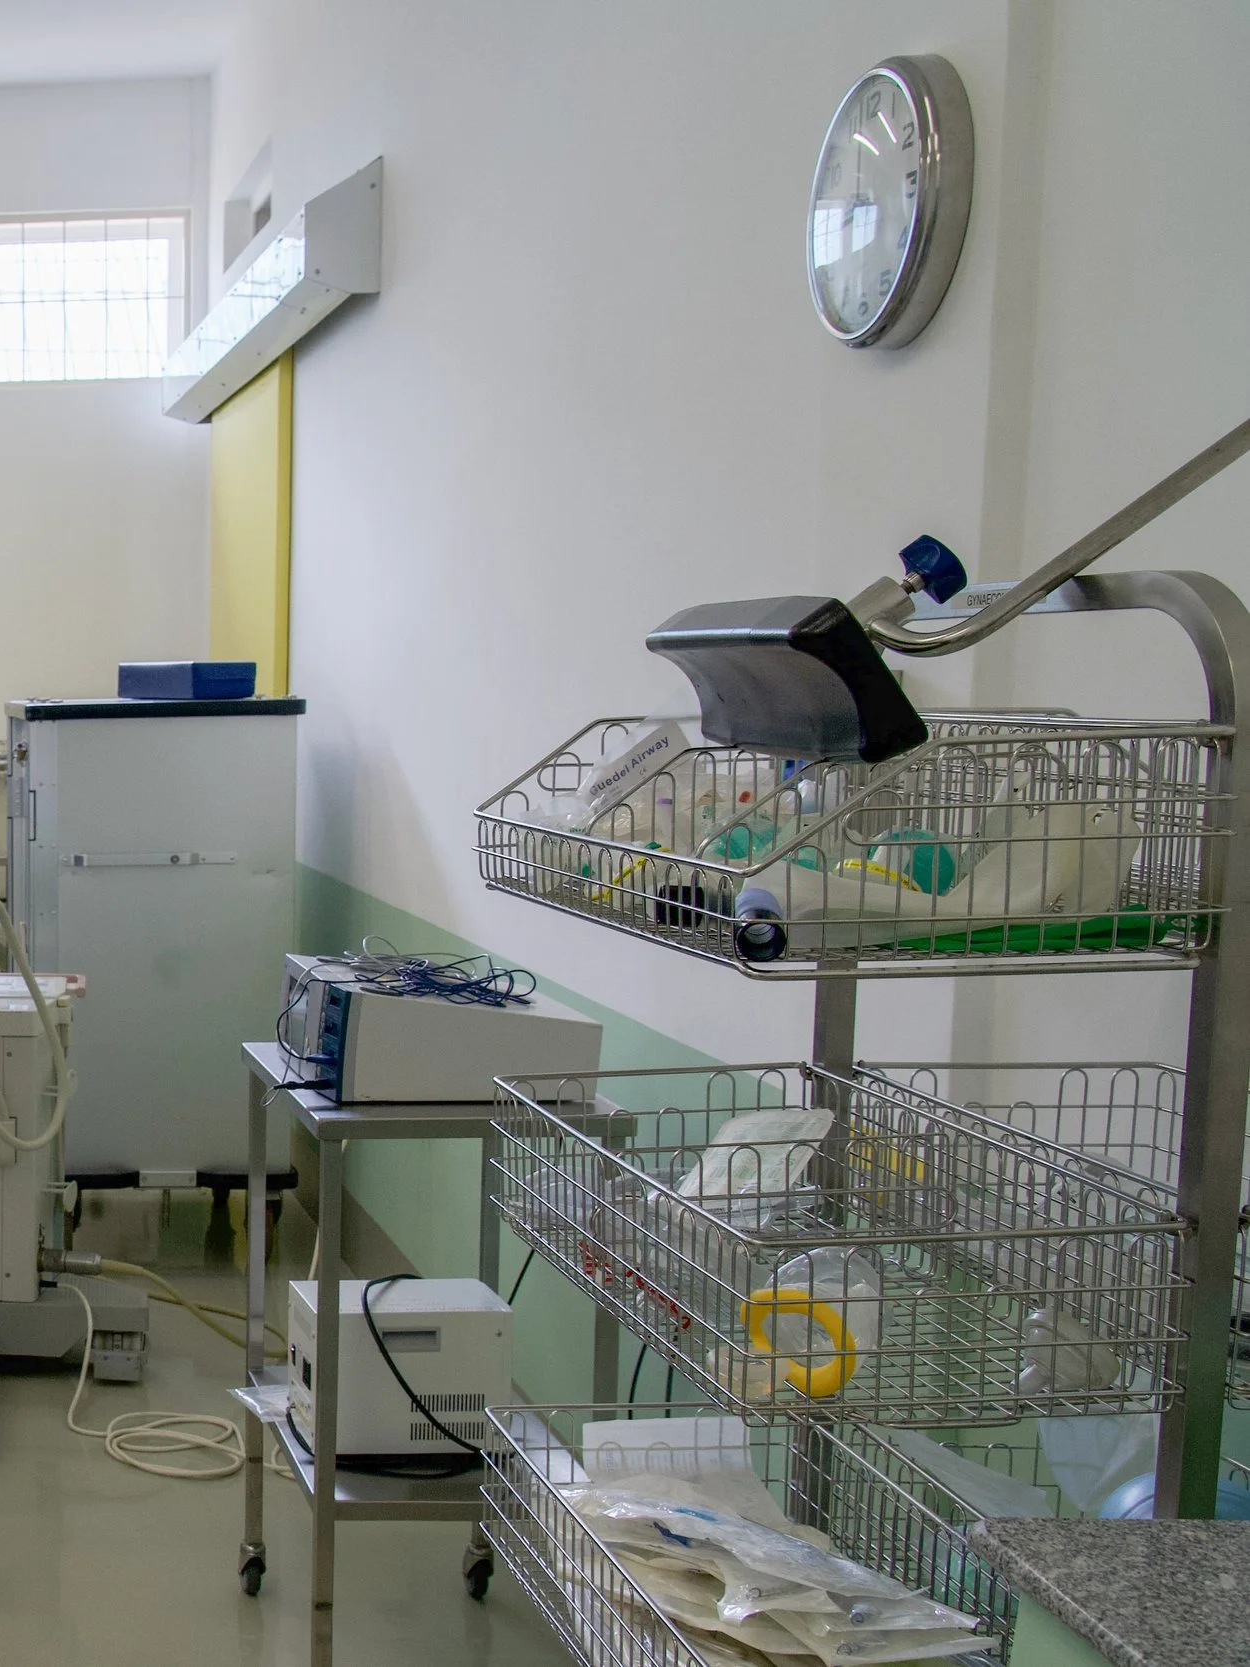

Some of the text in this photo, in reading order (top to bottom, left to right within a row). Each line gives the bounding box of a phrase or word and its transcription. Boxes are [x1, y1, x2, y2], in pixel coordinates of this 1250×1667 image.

[866, 91, 882, 120] 12
[901, 121, 916, 151] 2
[905, 170, 918, 199] 3
[879, 268, 893, 297] 5
[590, 764, 630, 796] Guedel
[631, 737, 670, 768] Airway
